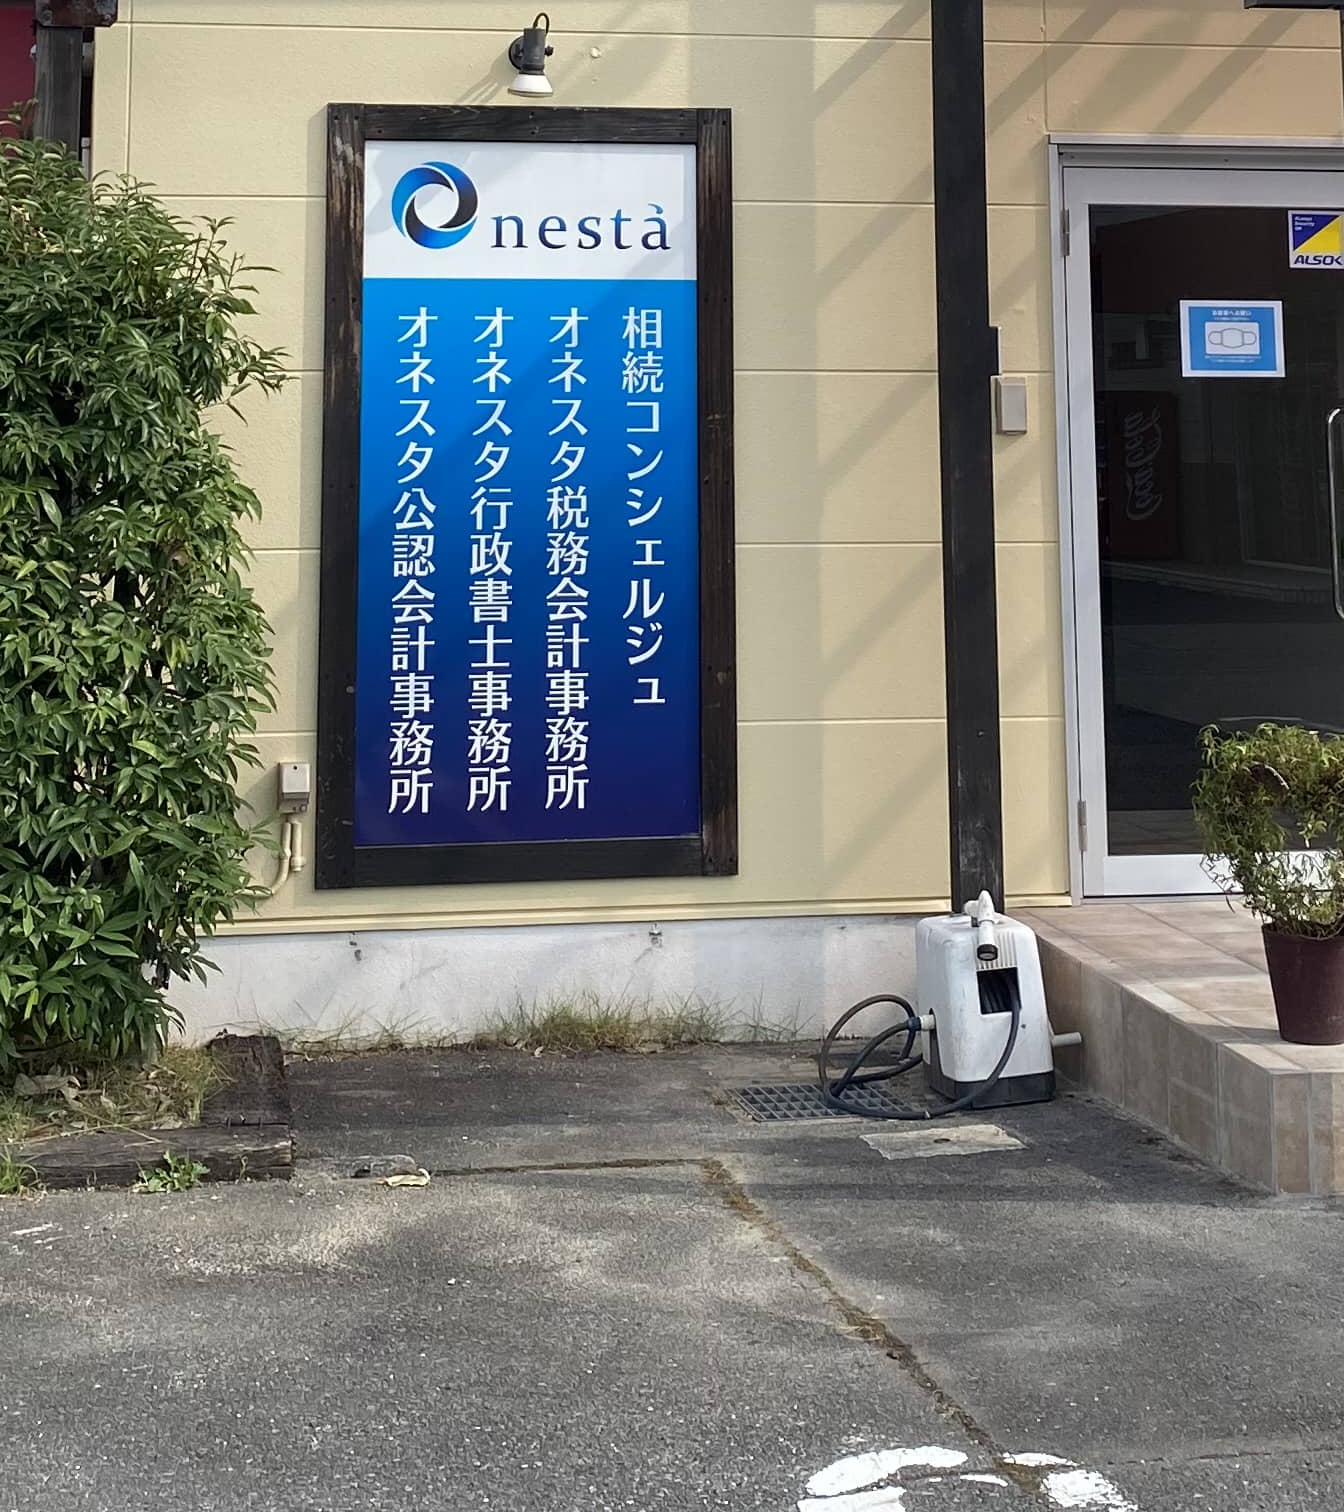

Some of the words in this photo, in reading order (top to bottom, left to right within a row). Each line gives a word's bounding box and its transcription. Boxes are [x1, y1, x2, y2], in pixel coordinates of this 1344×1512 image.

[621, 307, 666, 704] 相続コンシェルジュ
[1293, 254, 1344, 266] ALSOK
[388, 306, 438, 814] オネスタ公認会計事務所
[466, 306, 514, 812] オネスタ行政書士事務所
[545, 307, 590, 811] オネスタ税務会計事務所
